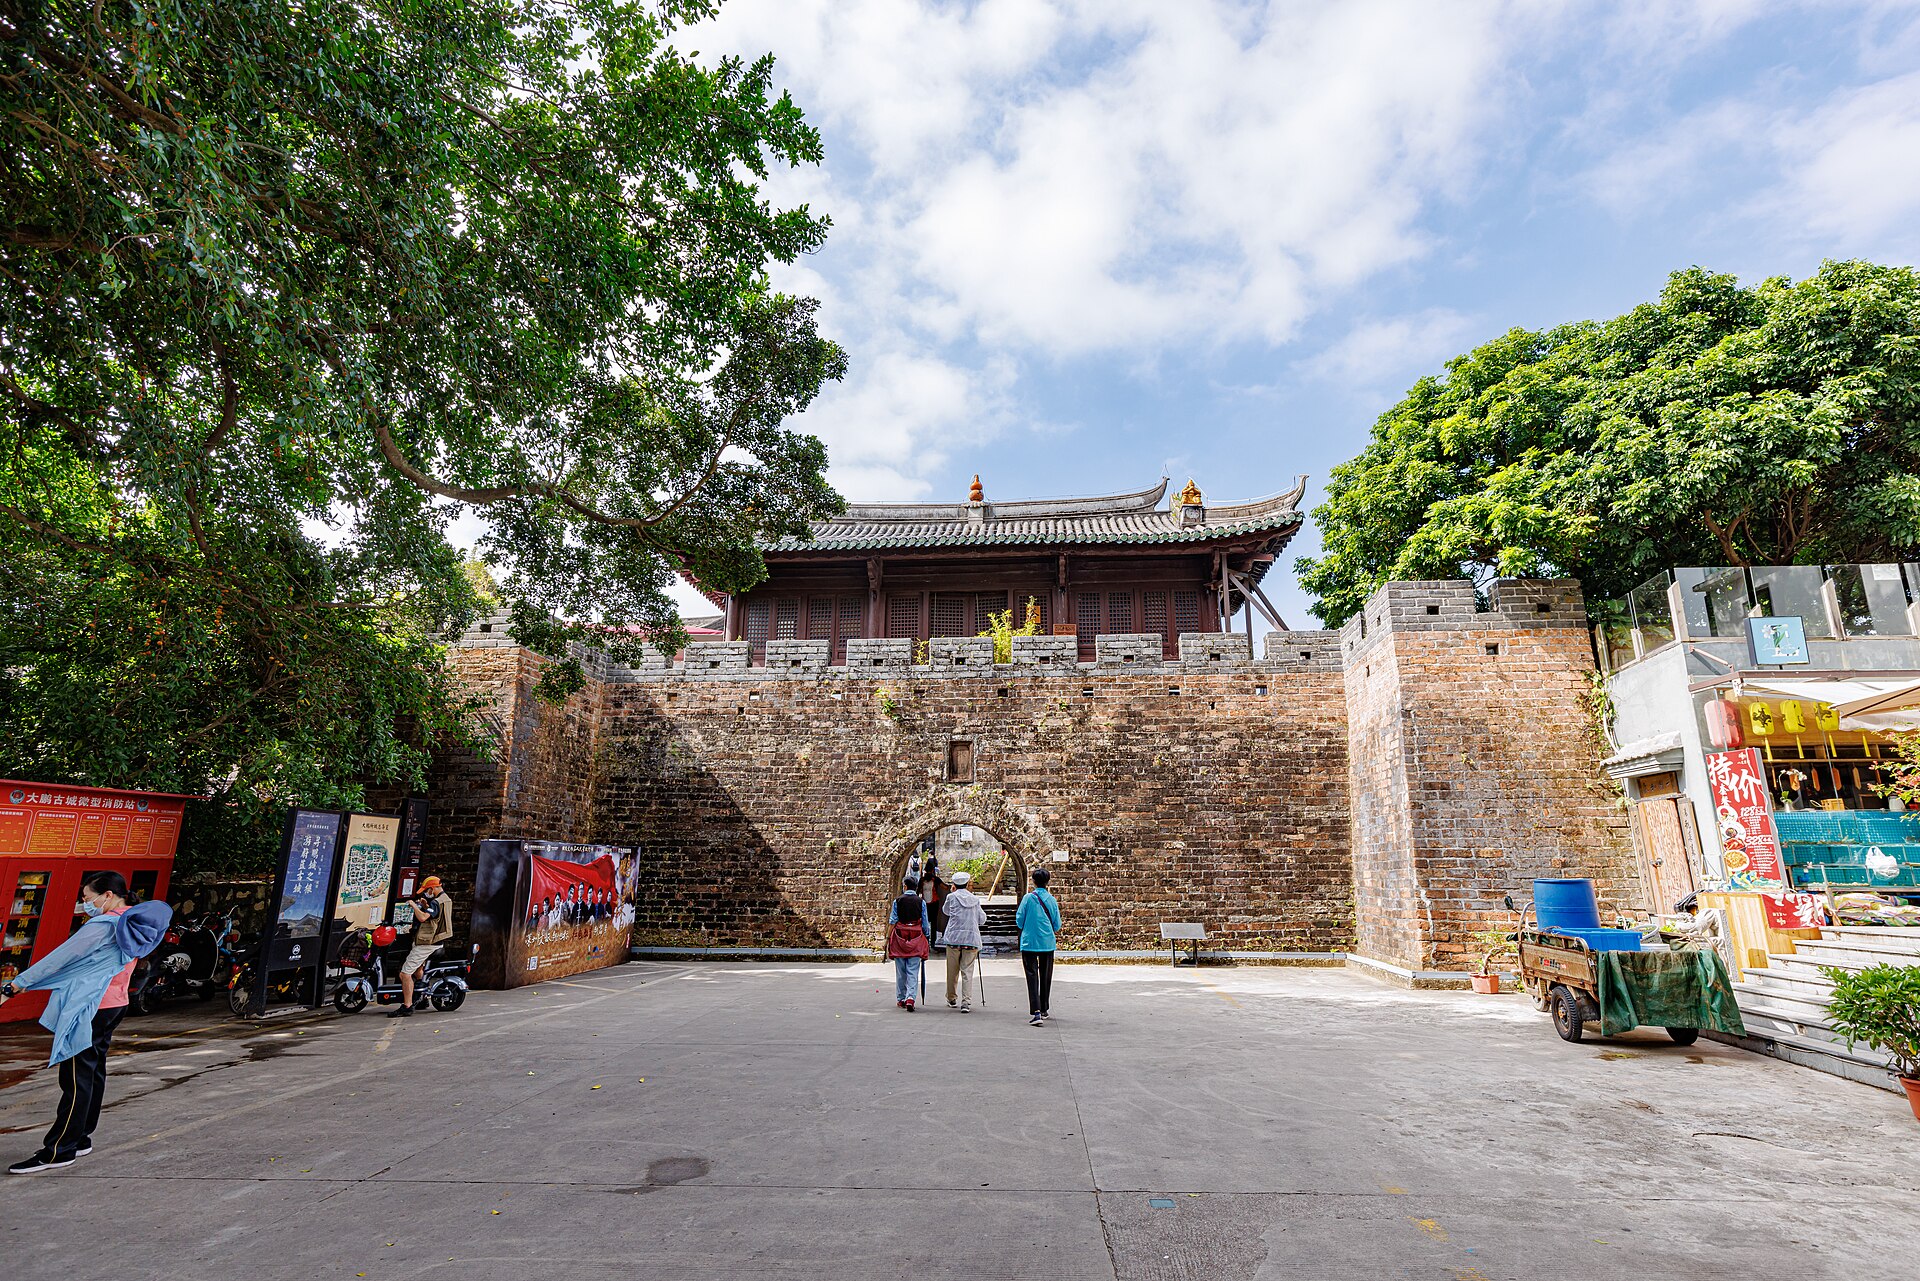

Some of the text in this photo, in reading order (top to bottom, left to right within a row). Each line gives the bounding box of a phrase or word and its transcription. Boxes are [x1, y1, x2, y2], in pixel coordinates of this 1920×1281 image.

[1708, 753, 1761, 806] 特价
[26, 792, 135, 809] 大鹏古城微型消防站
[1740, 806, 1756, 817] 128
[11, 891, 35, 956] 微型消防站
